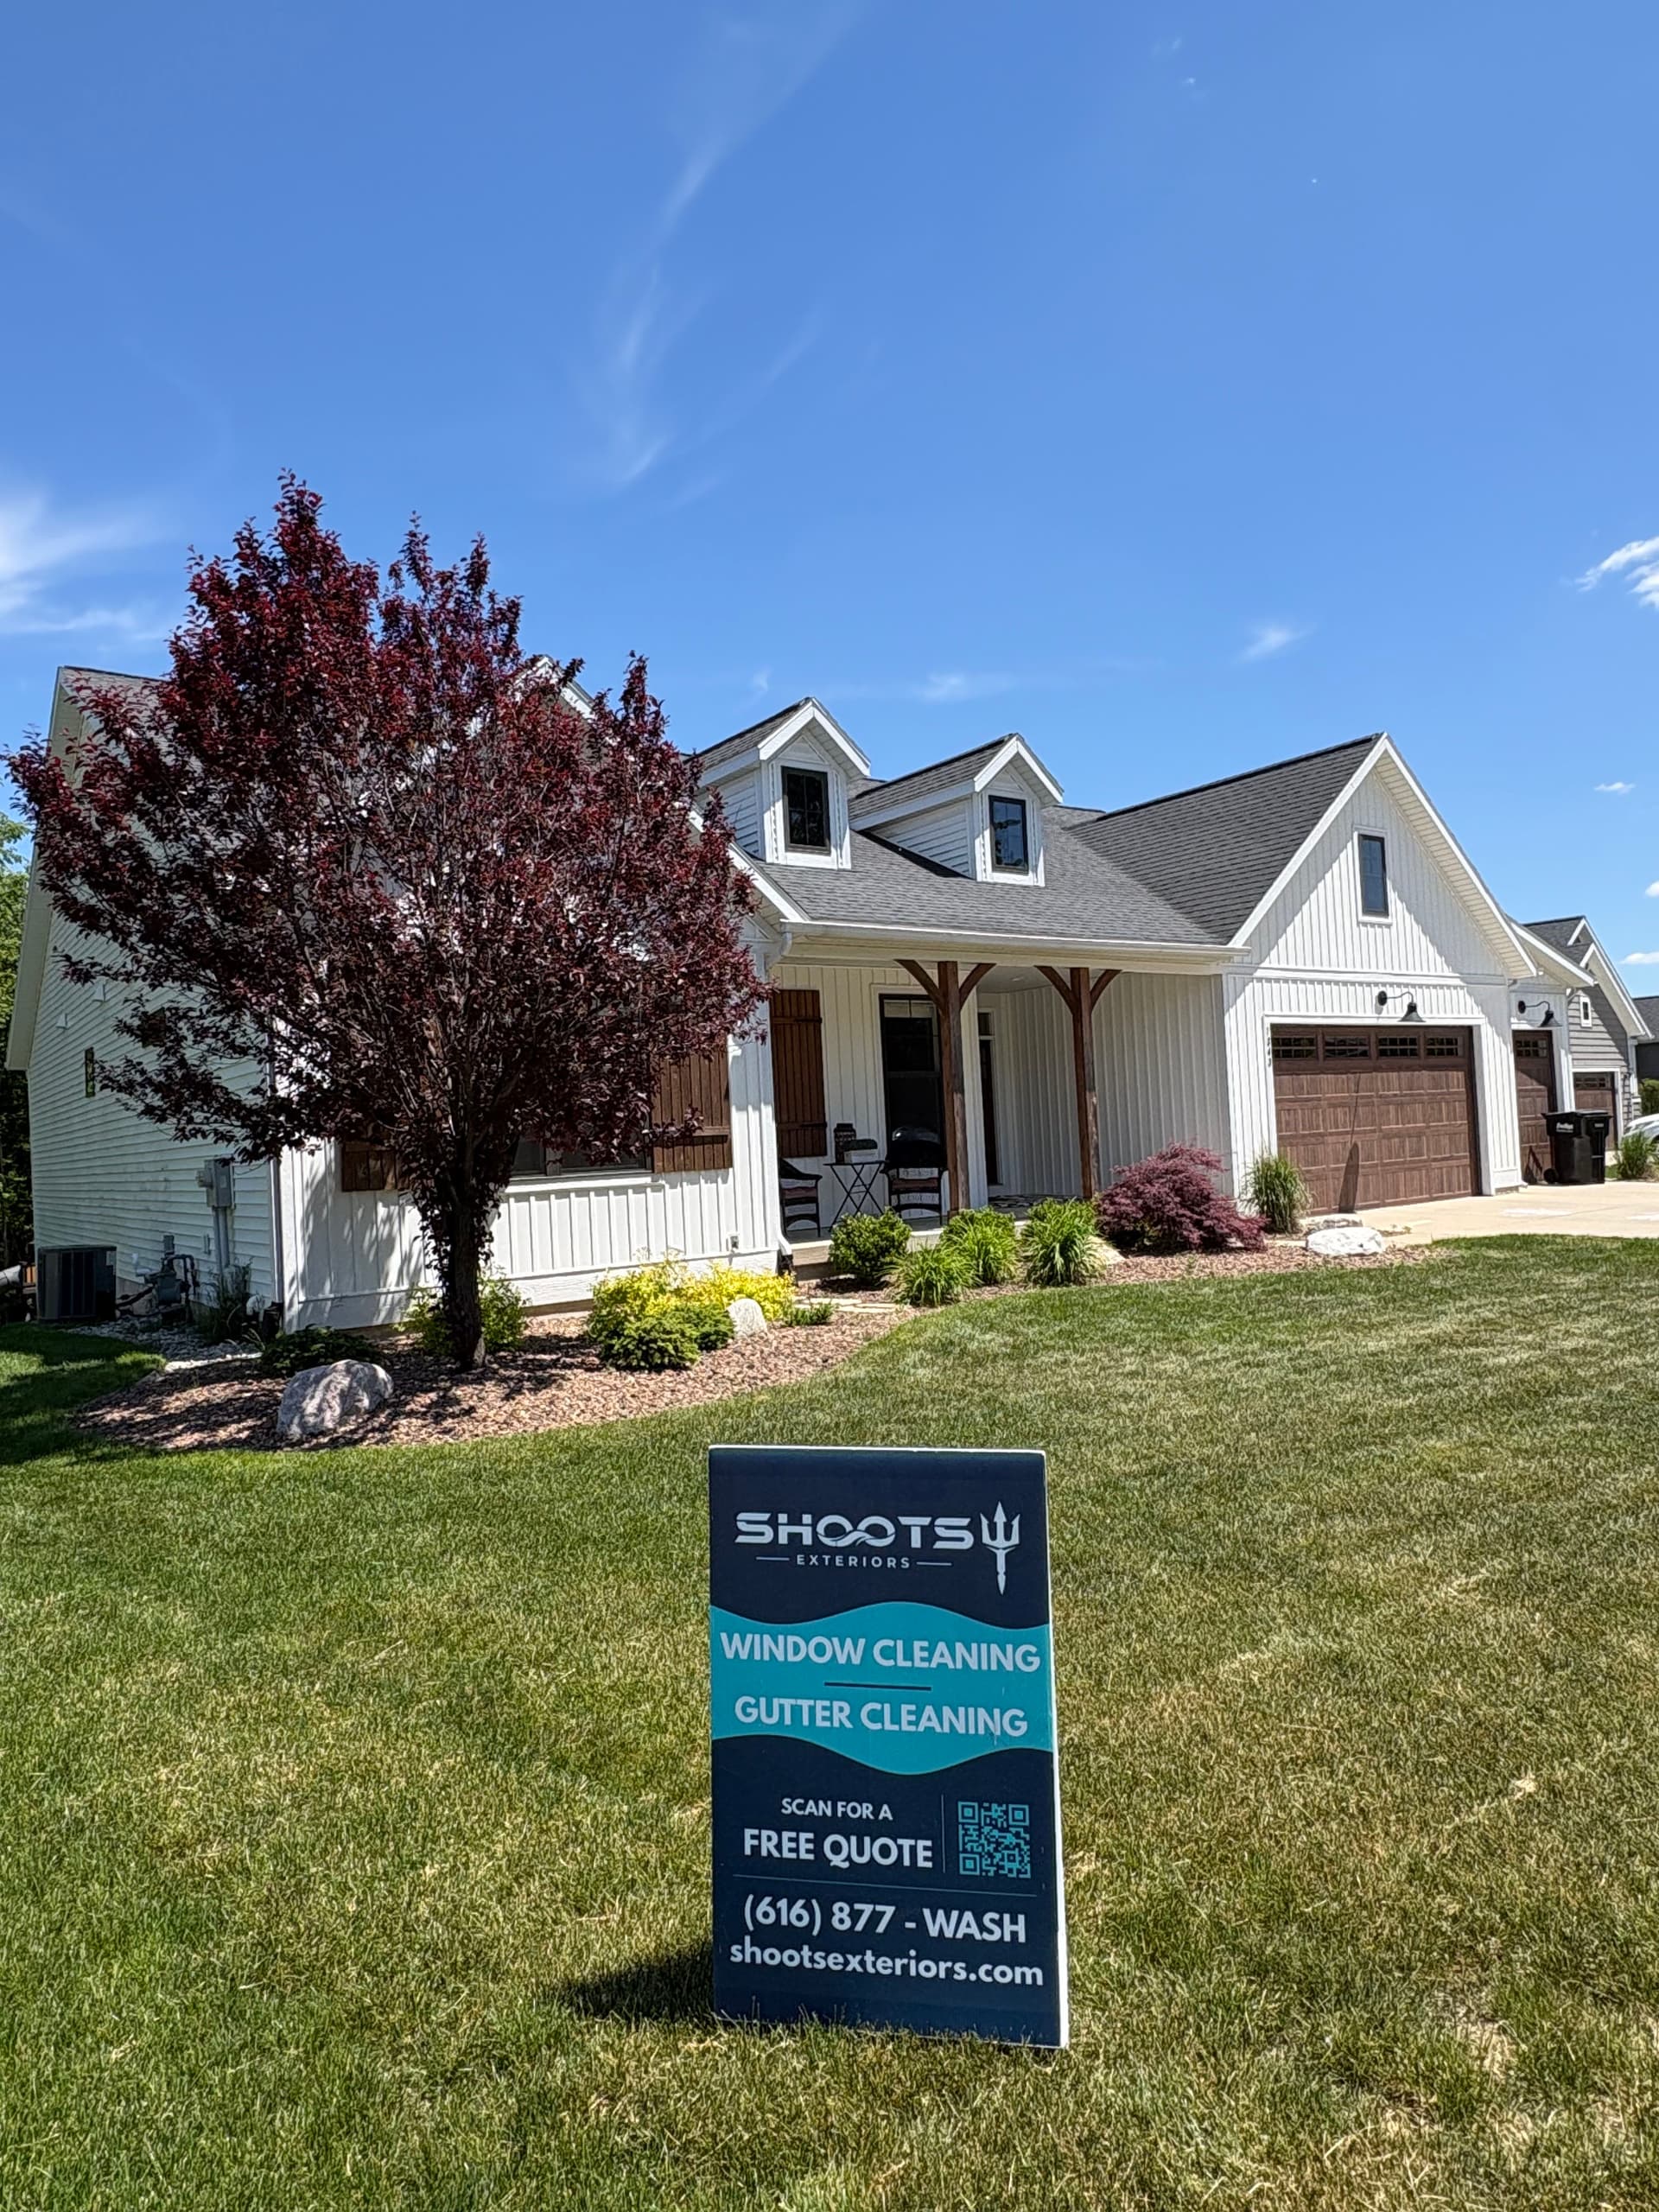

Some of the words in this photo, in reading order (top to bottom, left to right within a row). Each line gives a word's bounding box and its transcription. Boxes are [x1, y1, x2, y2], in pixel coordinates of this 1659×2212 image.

[734, 1512, 975, 1549] SHOOTS
[797, 1554, 910, 1568] EXTERIORS
[720, 1632, 865, 1665] WINDOW
[873, 1639, 1040, 1673] CLEANING
[734, 1696, 853, 1728] GUTTER
[860, 1702, 1028, 1737] CLEANING
[781, 1798, 832, 1817] SCAN
[837, 1802, 874, 1820] FOR
[878, 1803, 893, 1821] A
[744, 1828, 815, 1860] FREE
[823, 1834, 932, 1869] QUOTE
[744, 1894, 822, 1936] (616)
[831, 1902, 896, 1934] 877
[923, 1908, 1027, 1943] WASH
[730, 1936, 1043, 1986] shootsexteriors.com
